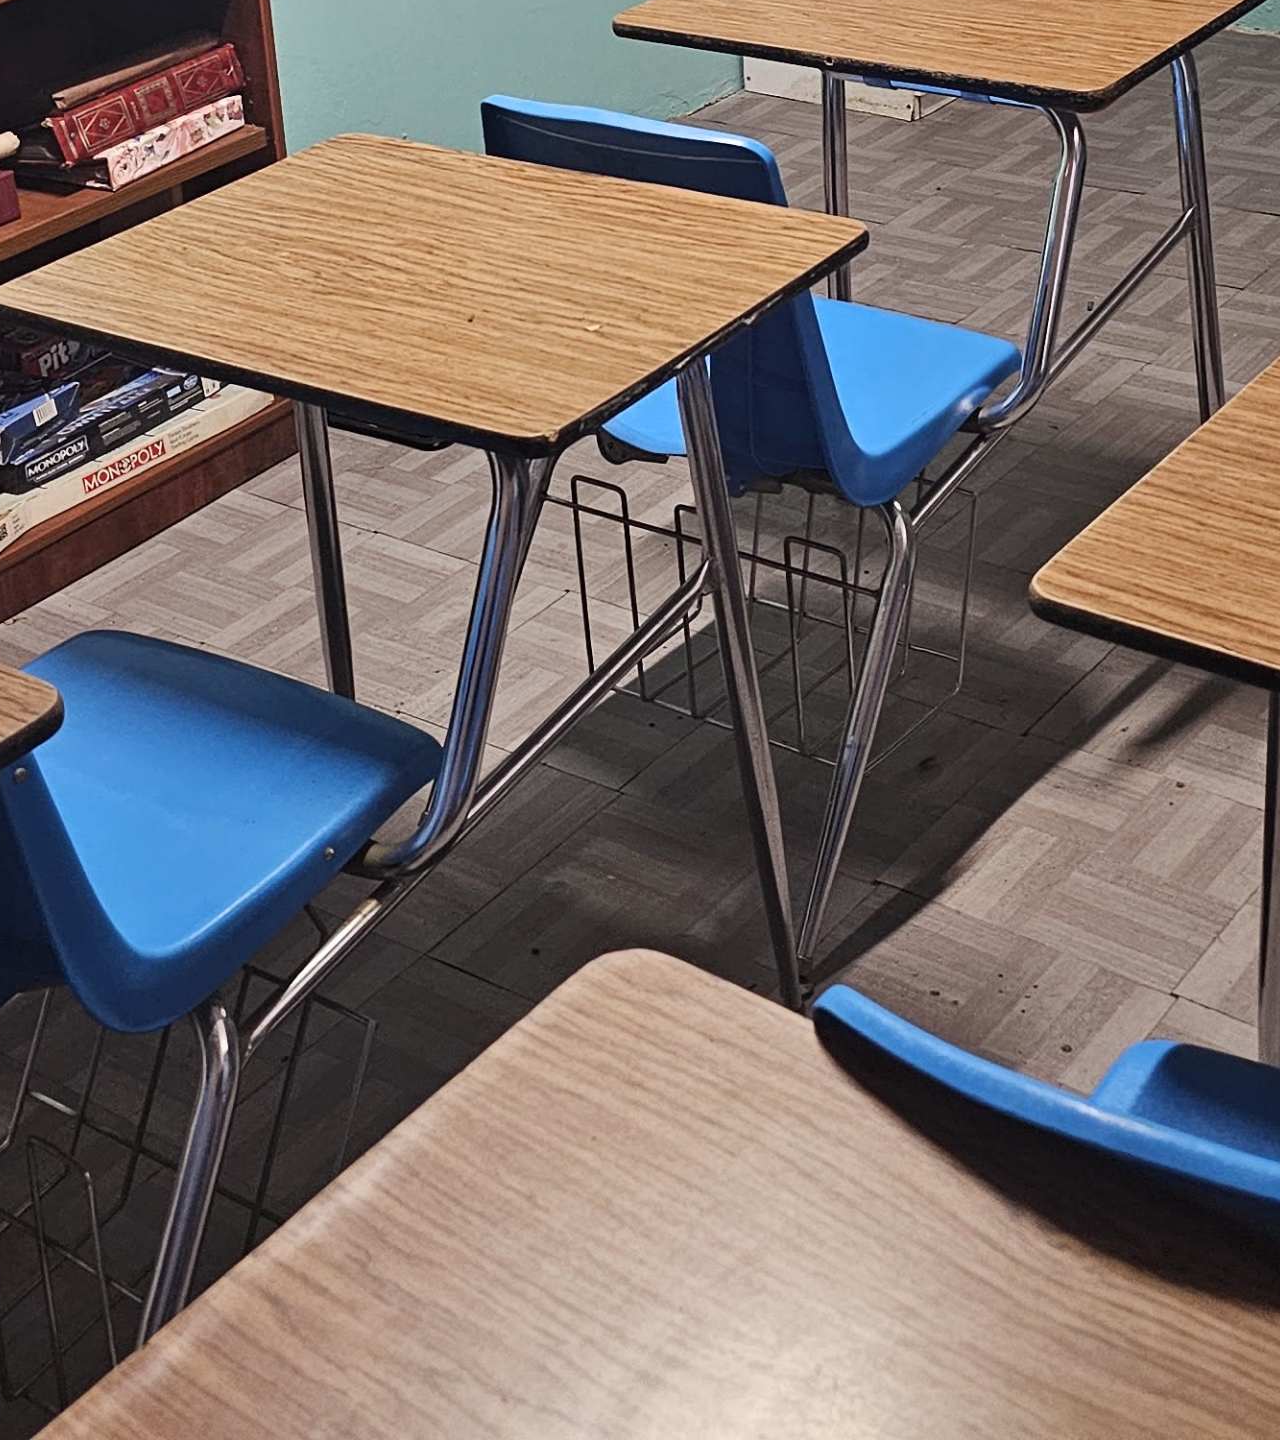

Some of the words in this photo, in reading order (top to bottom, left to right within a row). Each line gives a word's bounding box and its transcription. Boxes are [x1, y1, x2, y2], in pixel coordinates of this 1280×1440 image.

[39, 340, 70, 378] Pit
[28, 440, 86, 479] MONOPOLY
[83, 440, 166, 493] MONOPOLY
